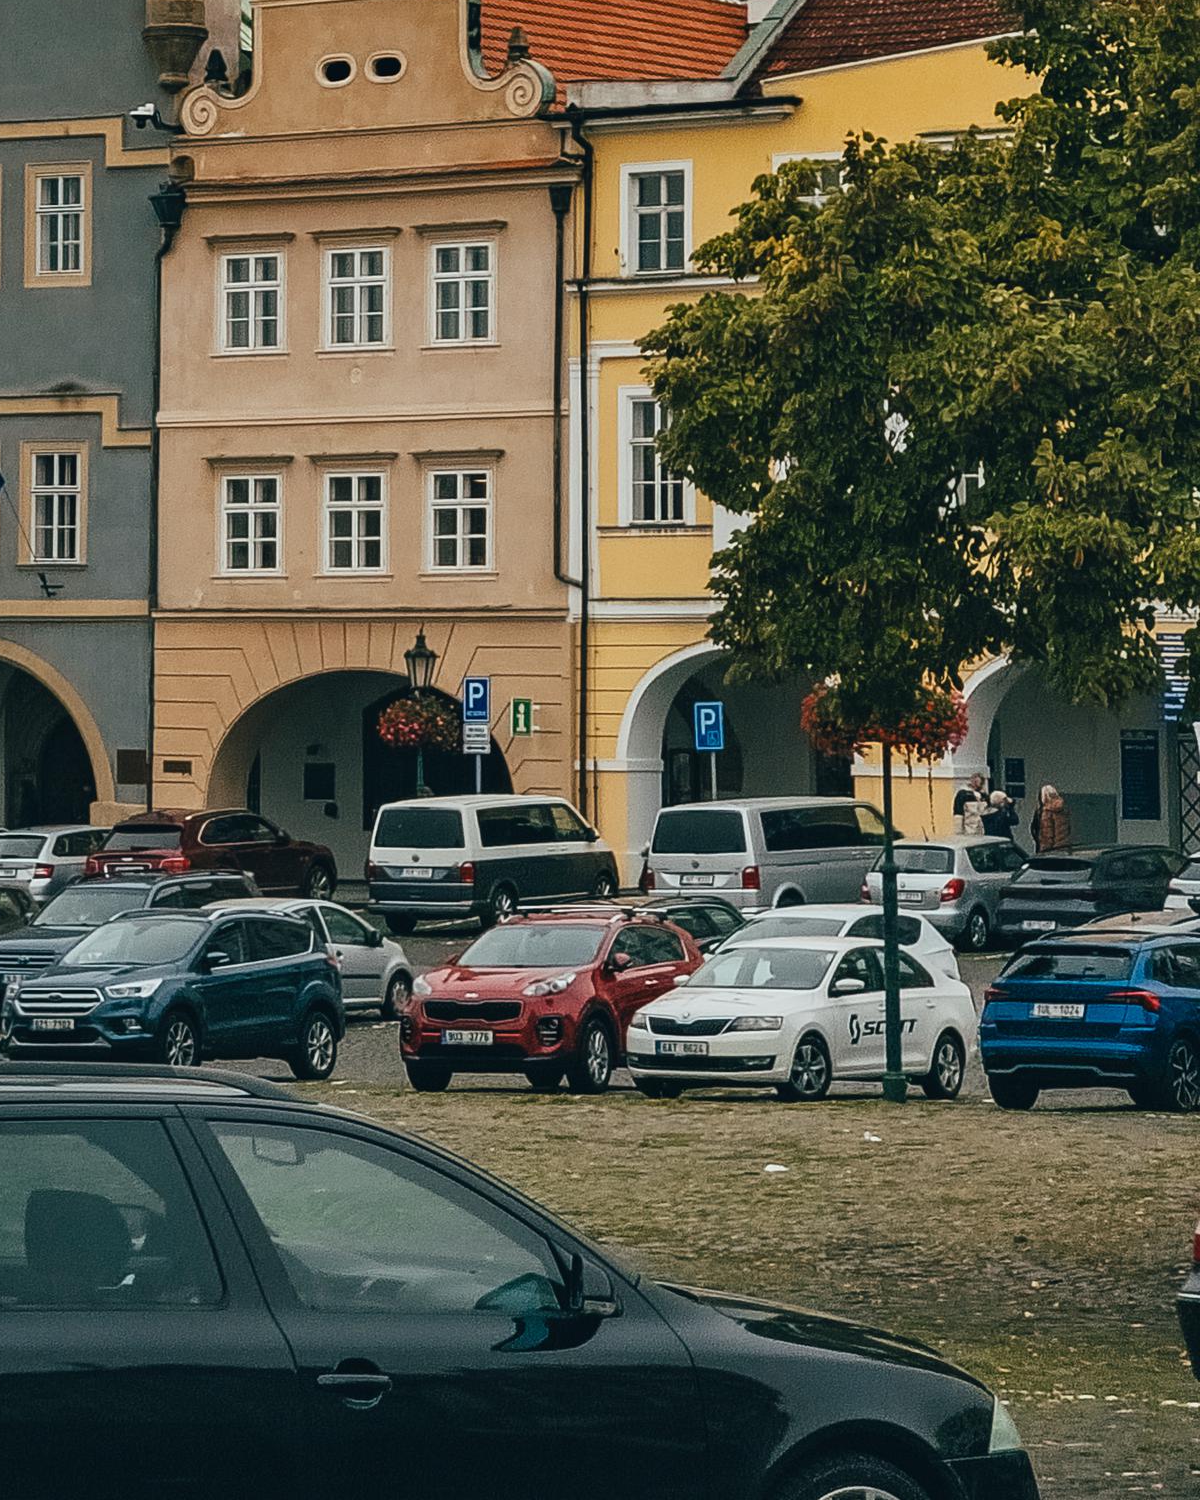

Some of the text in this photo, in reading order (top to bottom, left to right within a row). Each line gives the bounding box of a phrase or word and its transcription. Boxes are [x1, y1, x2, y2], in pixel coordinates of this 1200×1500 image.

[468, 682, 485, 709] P
[700, 708, 716, 735] P
[861, 1018, 918, 1037] SCTT
